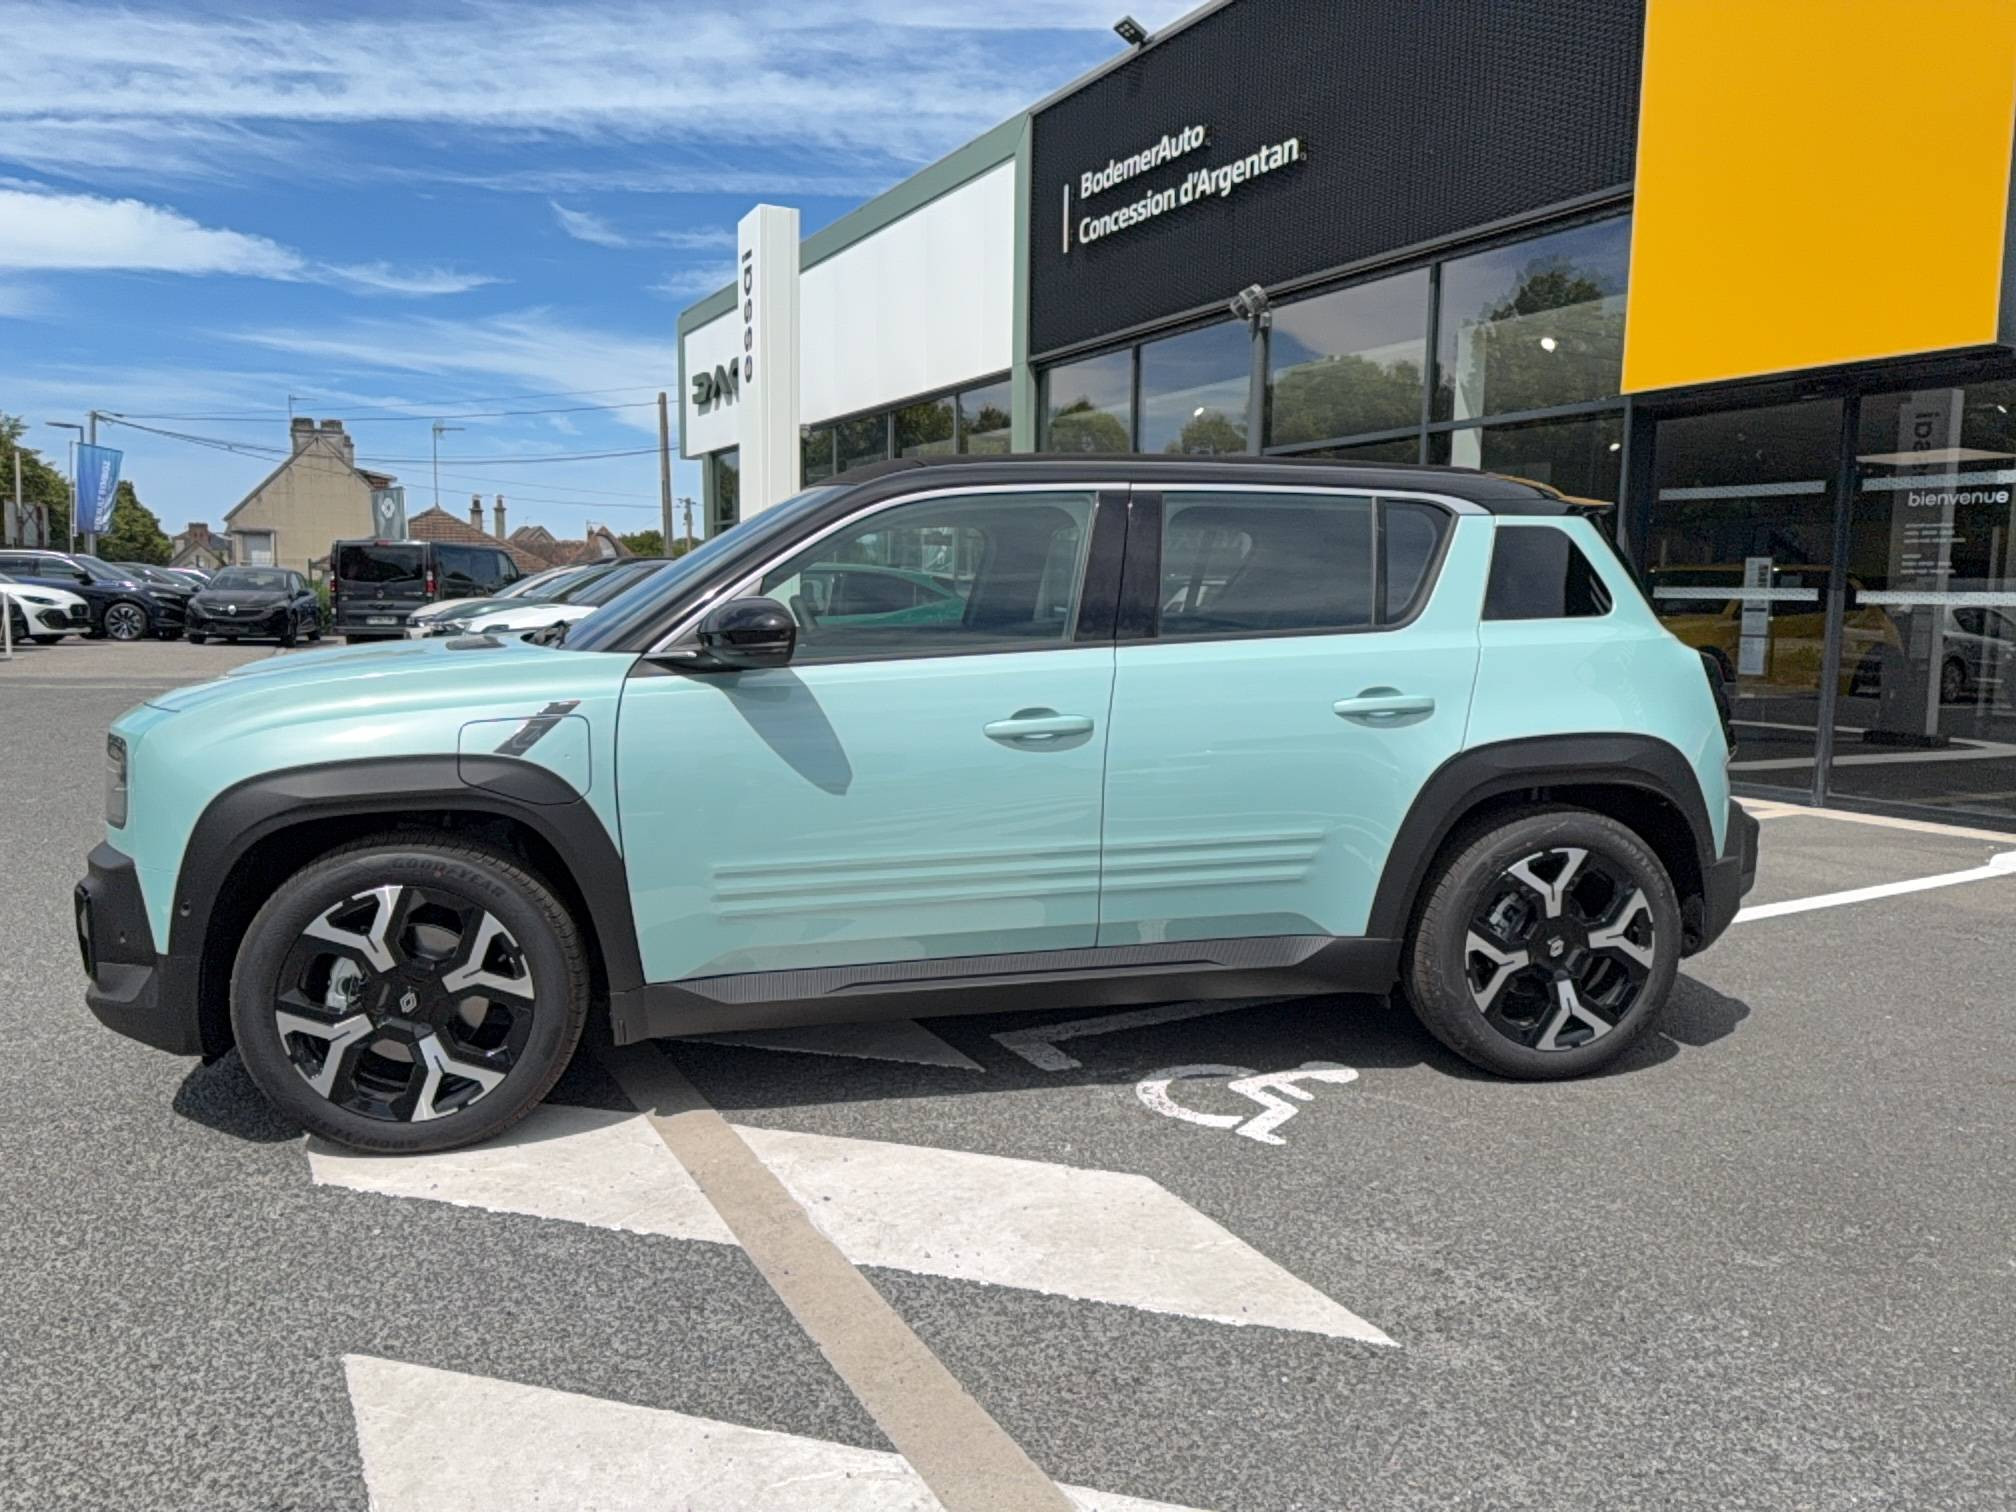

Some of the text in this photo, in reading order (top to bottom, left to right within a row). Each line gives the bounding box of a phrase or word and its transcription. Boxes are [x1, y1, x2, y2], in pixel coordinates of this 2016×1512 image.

[1078, 137, 1299, 244] Concession d'Argentan
[1080, 124, 1204, 199] BodemerAuto
[741, 249, 753, 383] essai
[1907, 490, 2009, 508] bienvenue
